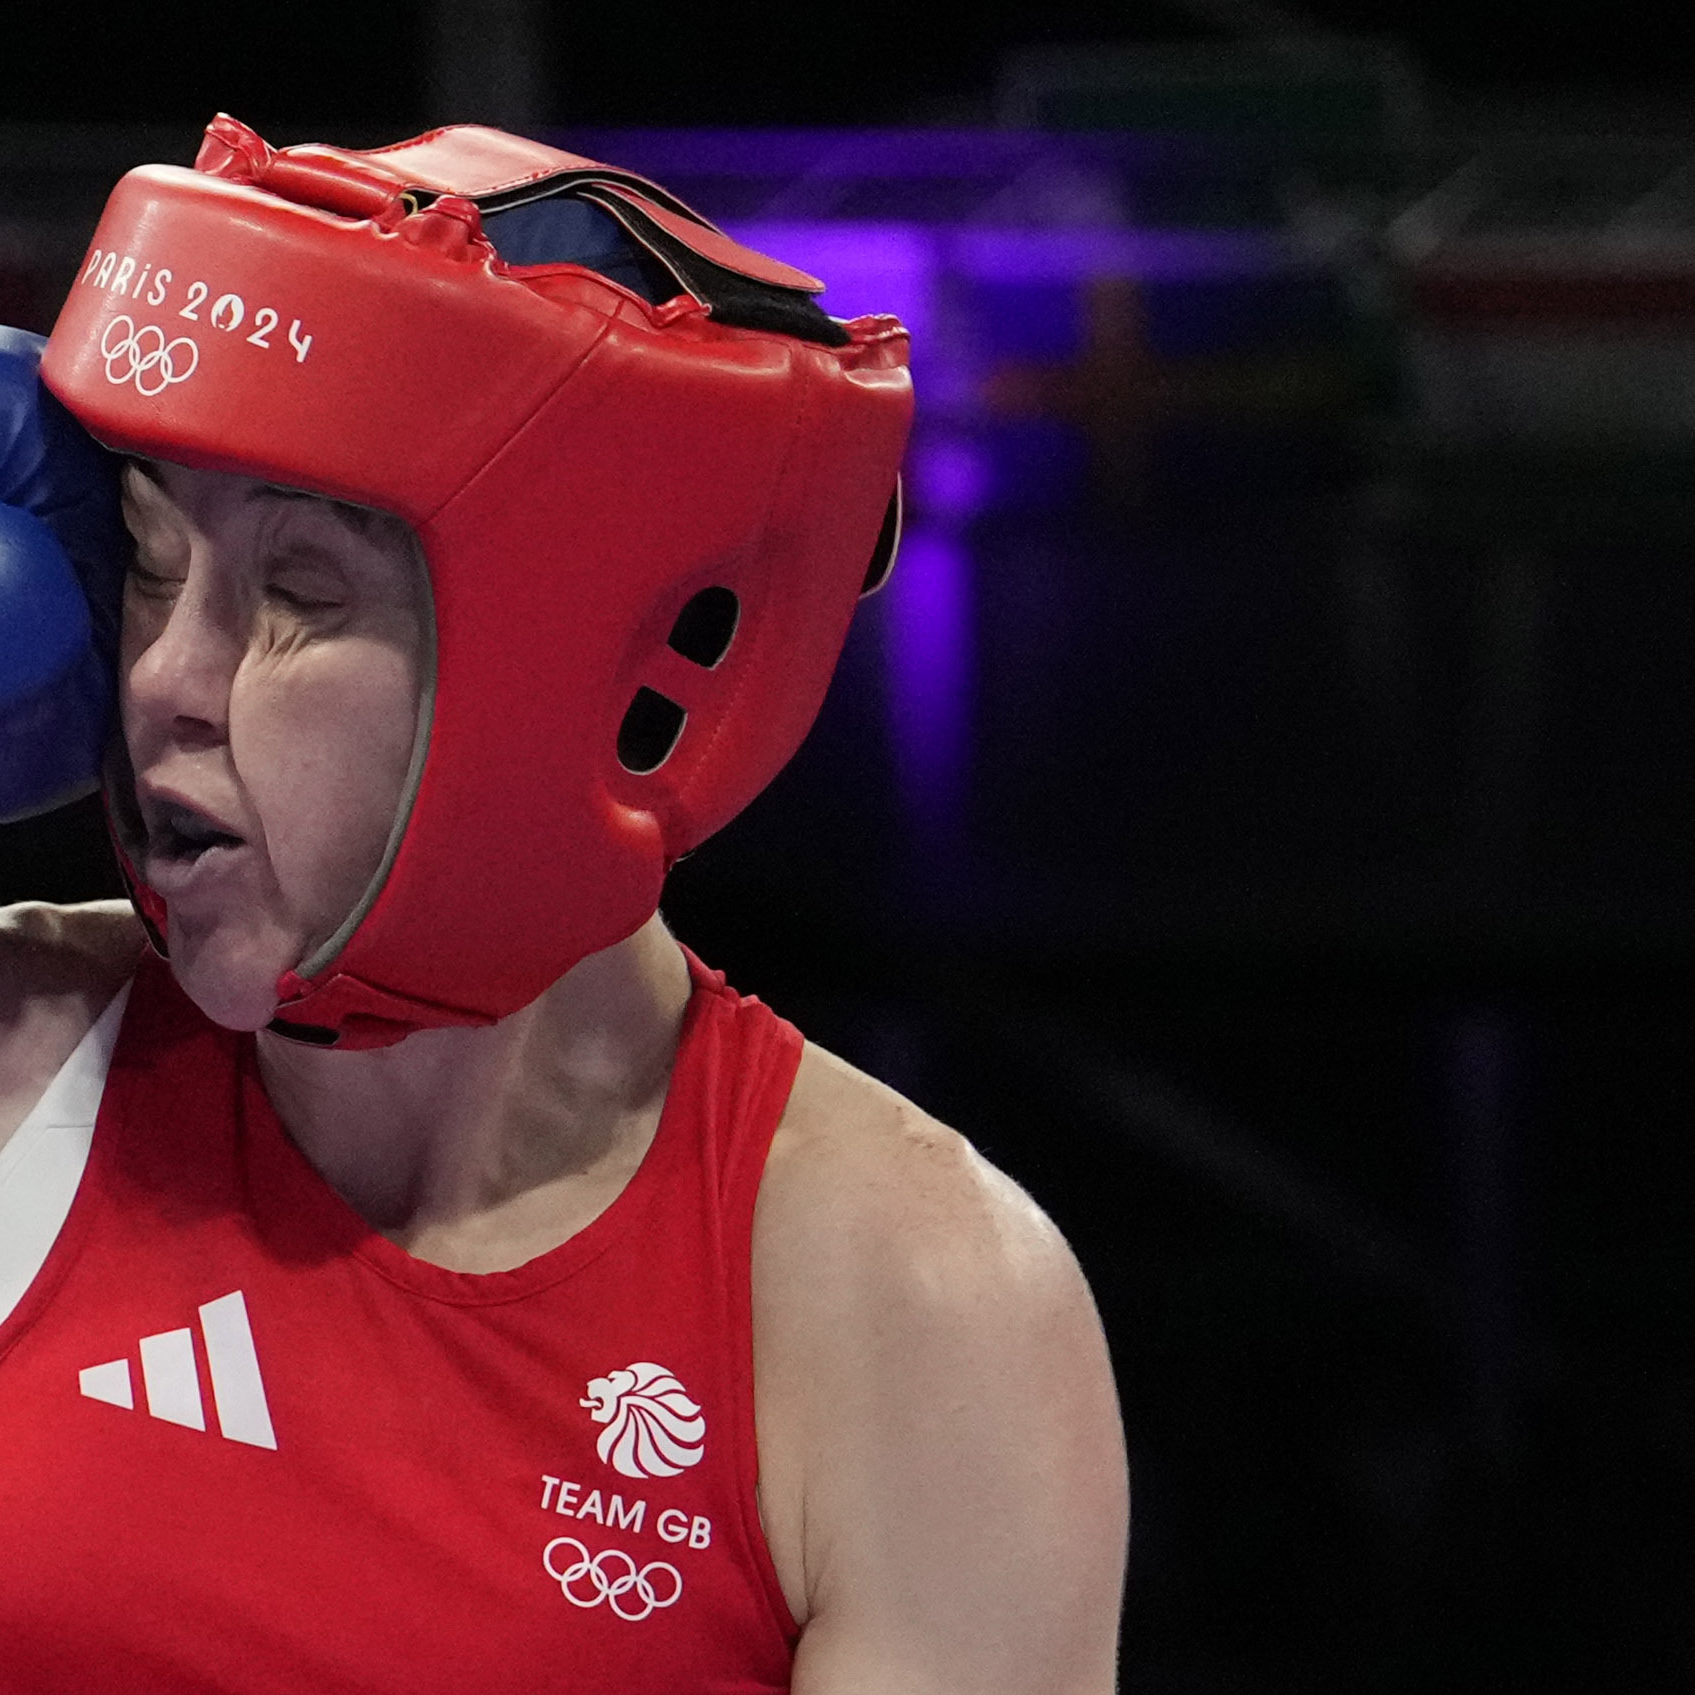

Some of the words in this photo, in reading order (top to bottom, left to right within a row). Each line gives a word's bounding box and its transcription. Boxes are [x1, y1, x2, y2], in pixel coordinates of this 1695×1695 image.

[178, 281, 312, 363] 2024
[541, 1474, 646, 1533] TEAM
[657, 1508, 712, 1549] GB
